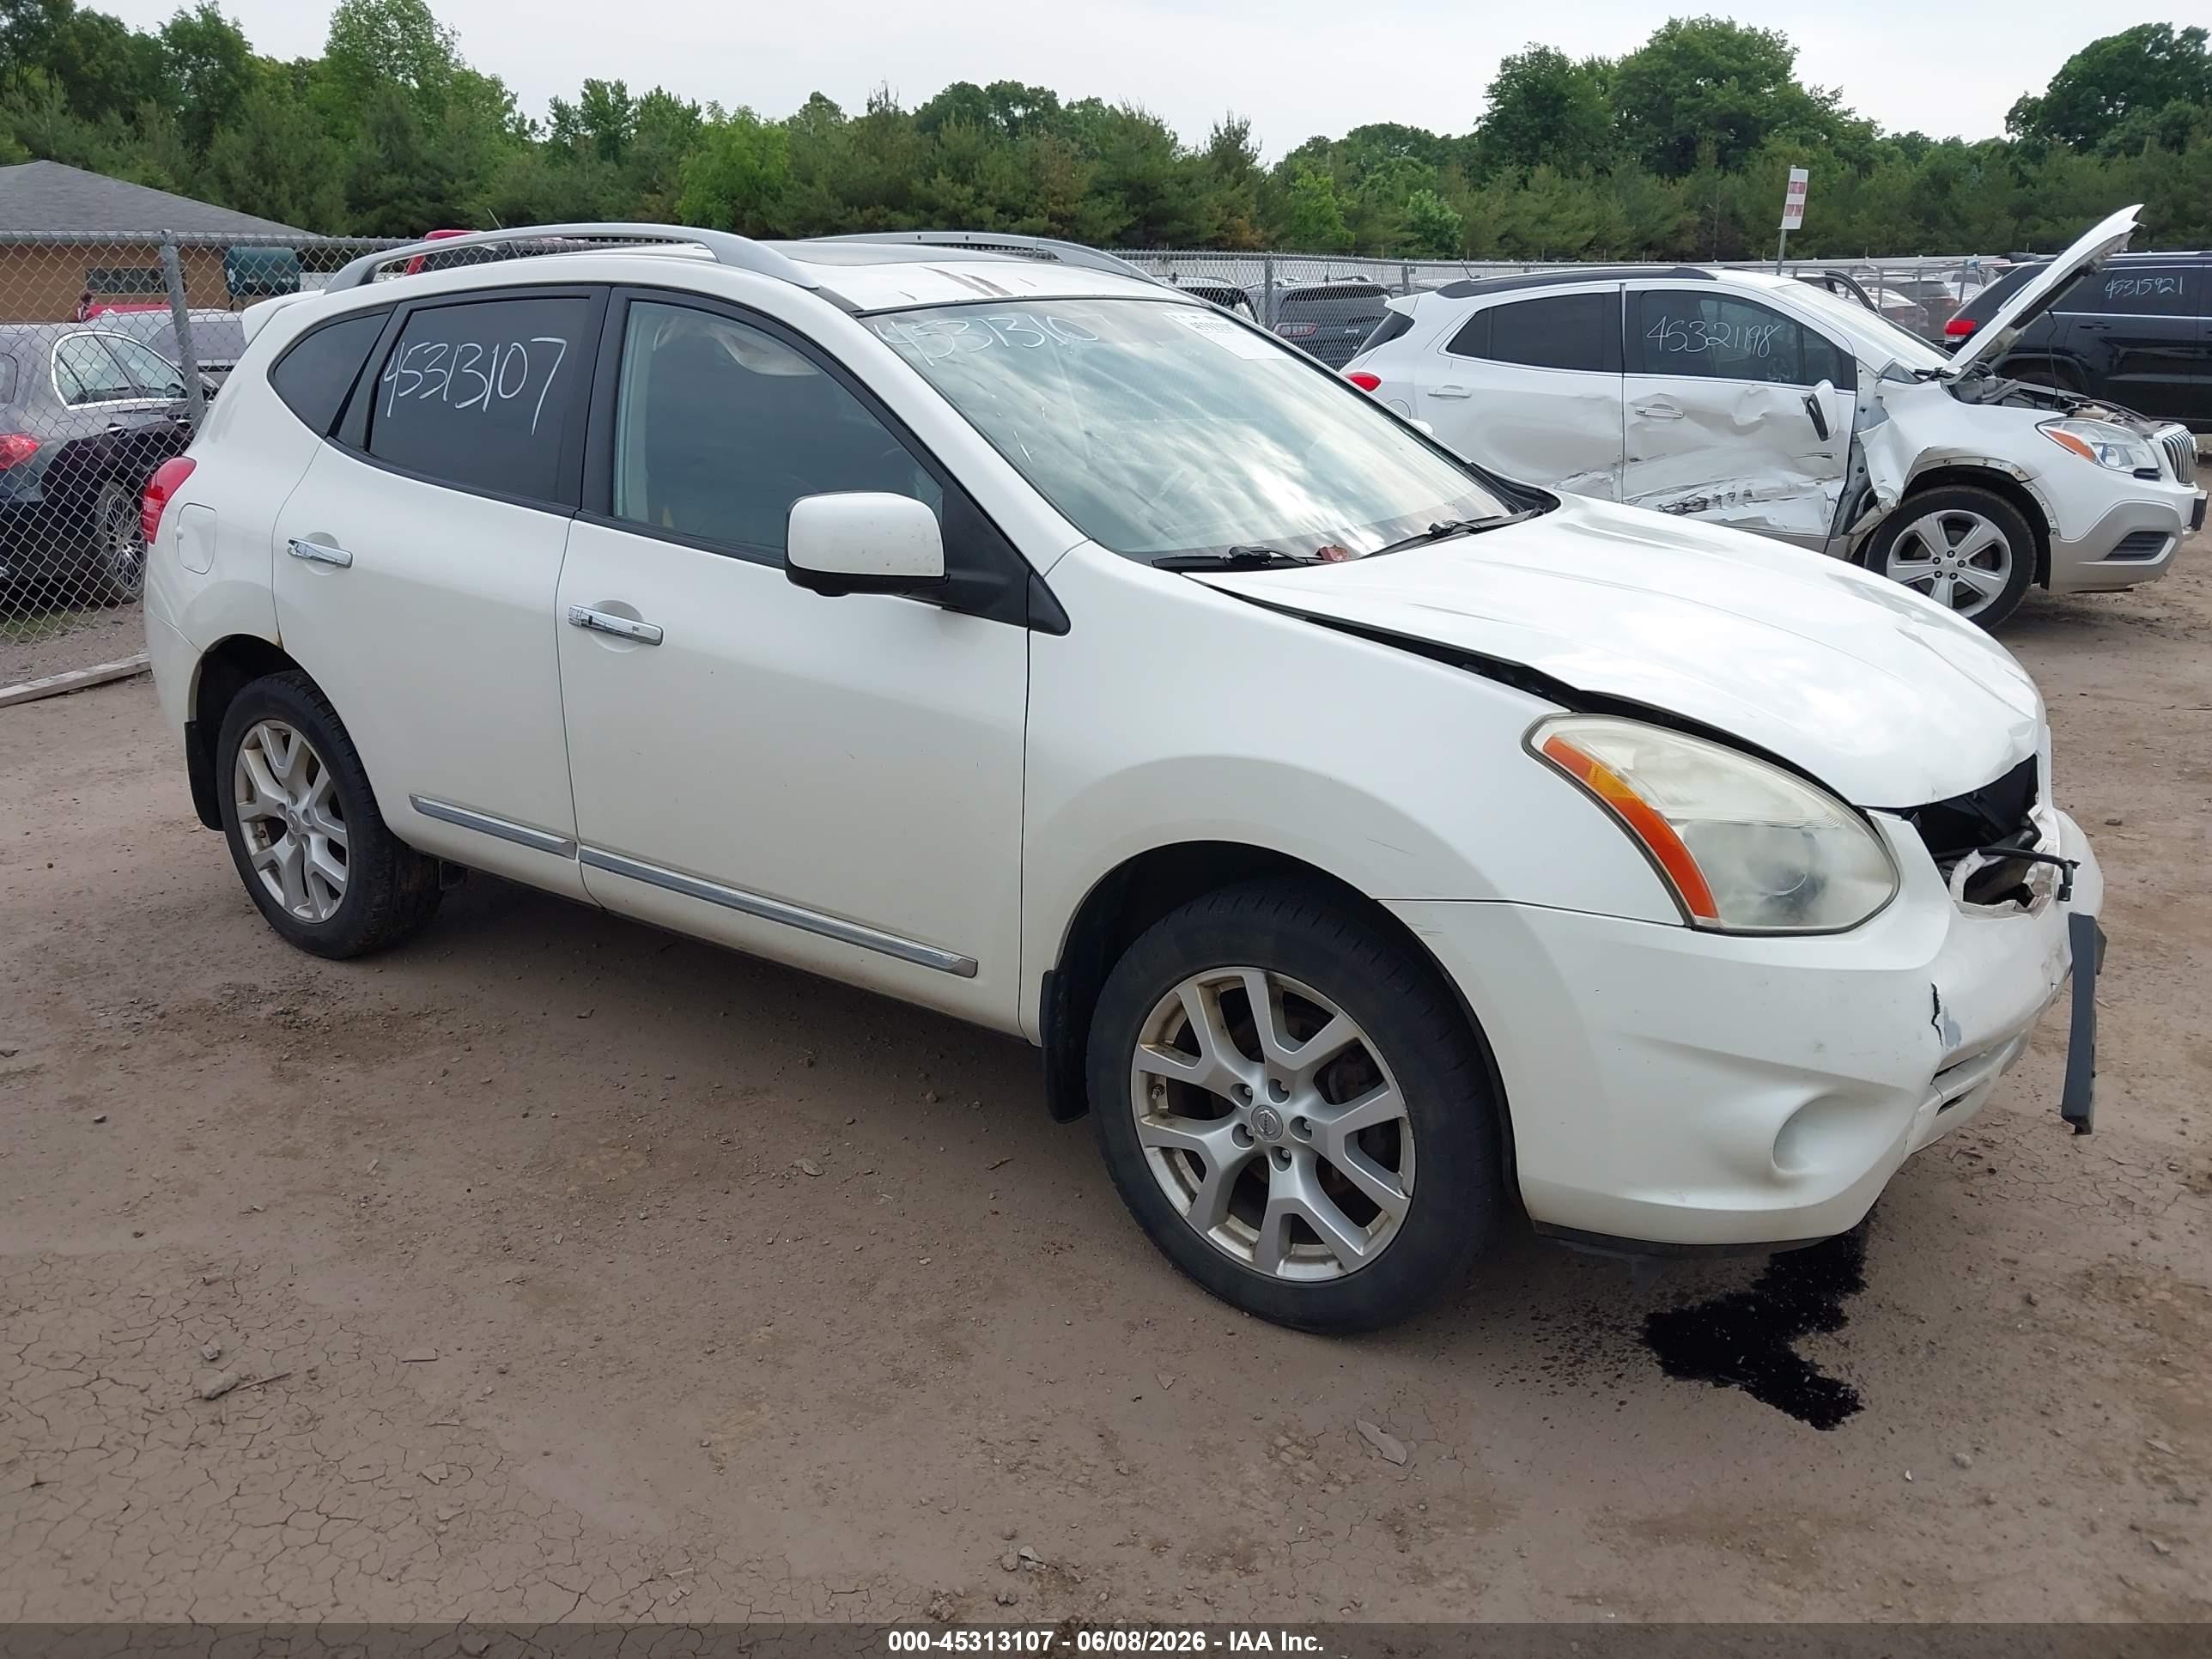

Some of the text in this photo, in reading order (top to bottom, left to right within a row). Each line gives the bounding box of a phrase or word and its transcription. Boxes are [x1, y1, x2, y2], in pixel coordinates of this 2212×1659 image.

[2105, 276, 2183, 299] 45315921
[1646, 315, 1782, 358] 45321198
[384, 337, 568, 436] 45313107
